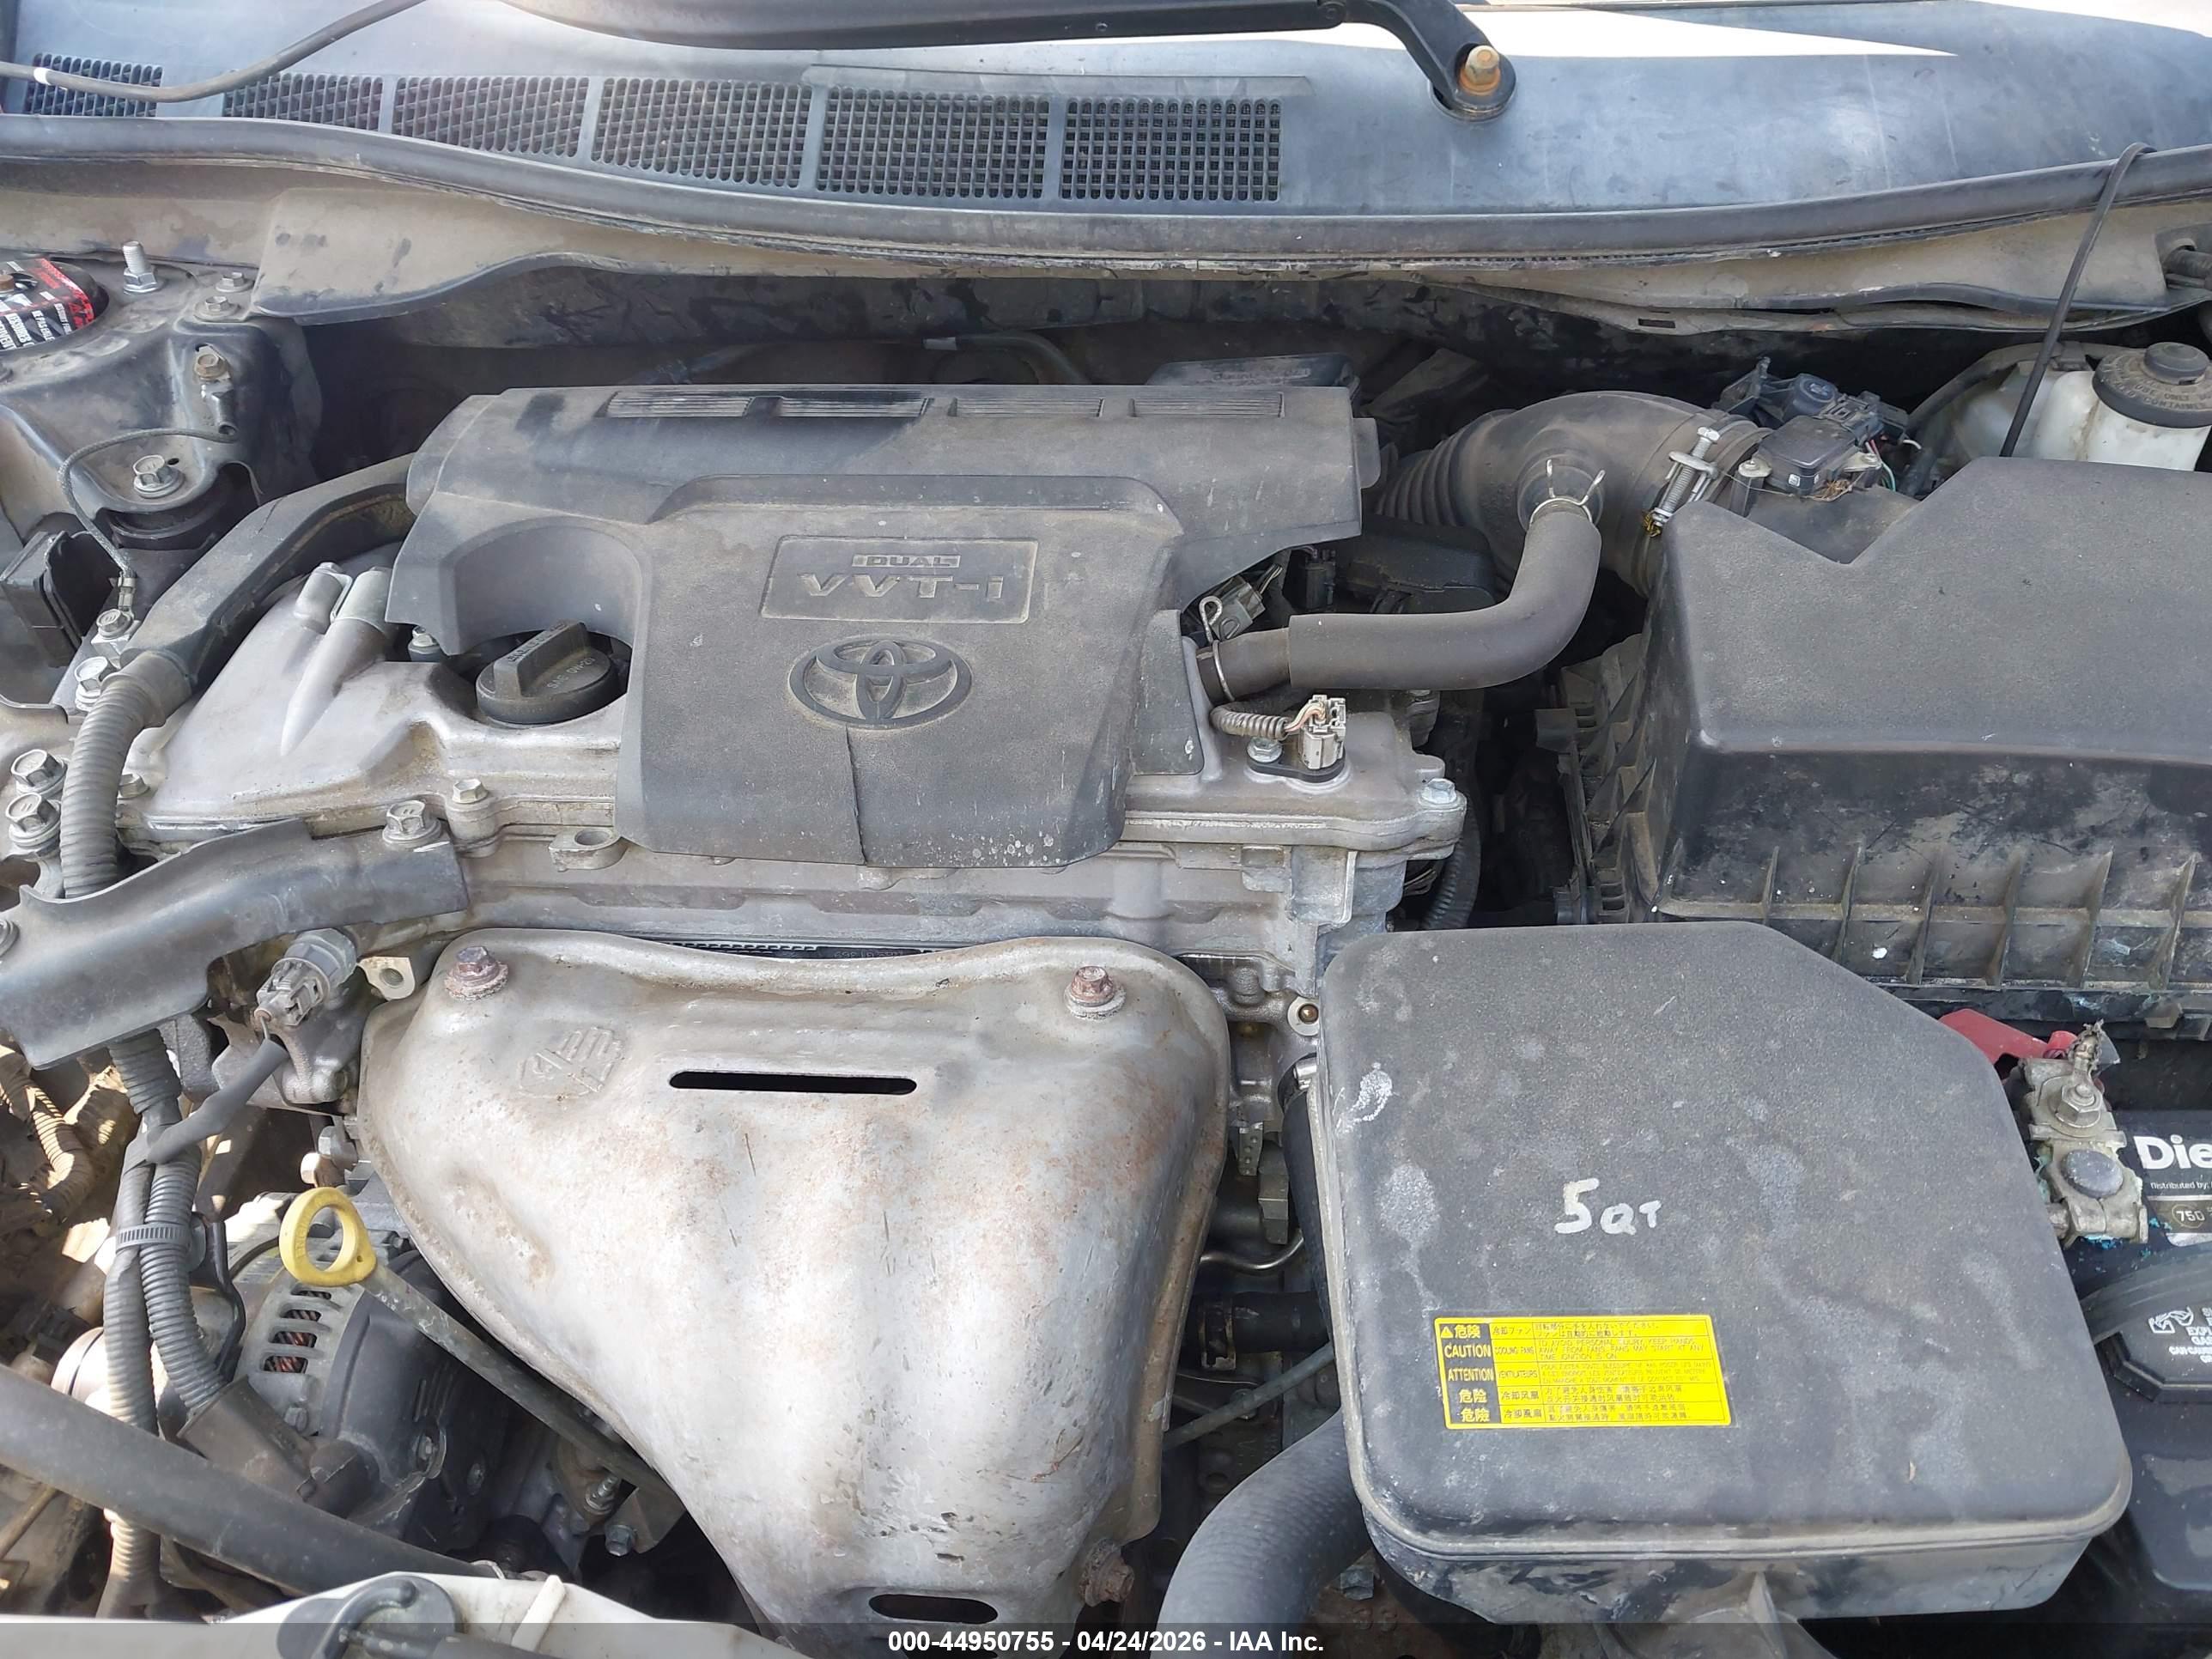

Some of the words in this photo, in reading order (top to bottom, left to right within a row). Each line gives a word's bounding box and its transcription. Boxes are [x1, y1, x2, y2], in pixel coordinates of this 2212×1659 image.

[866, 555, 953, 568] DUAL
[1454, 1325, 1481, 1339] 危険
[1444, 1345, 1492, 1358] CAUTION
[1448, 1368, 1494, 1382] ATTENTION
[1459, 1389, 1487, 1403] 危险
[1461, 1408, 1490, 1422] 危險
